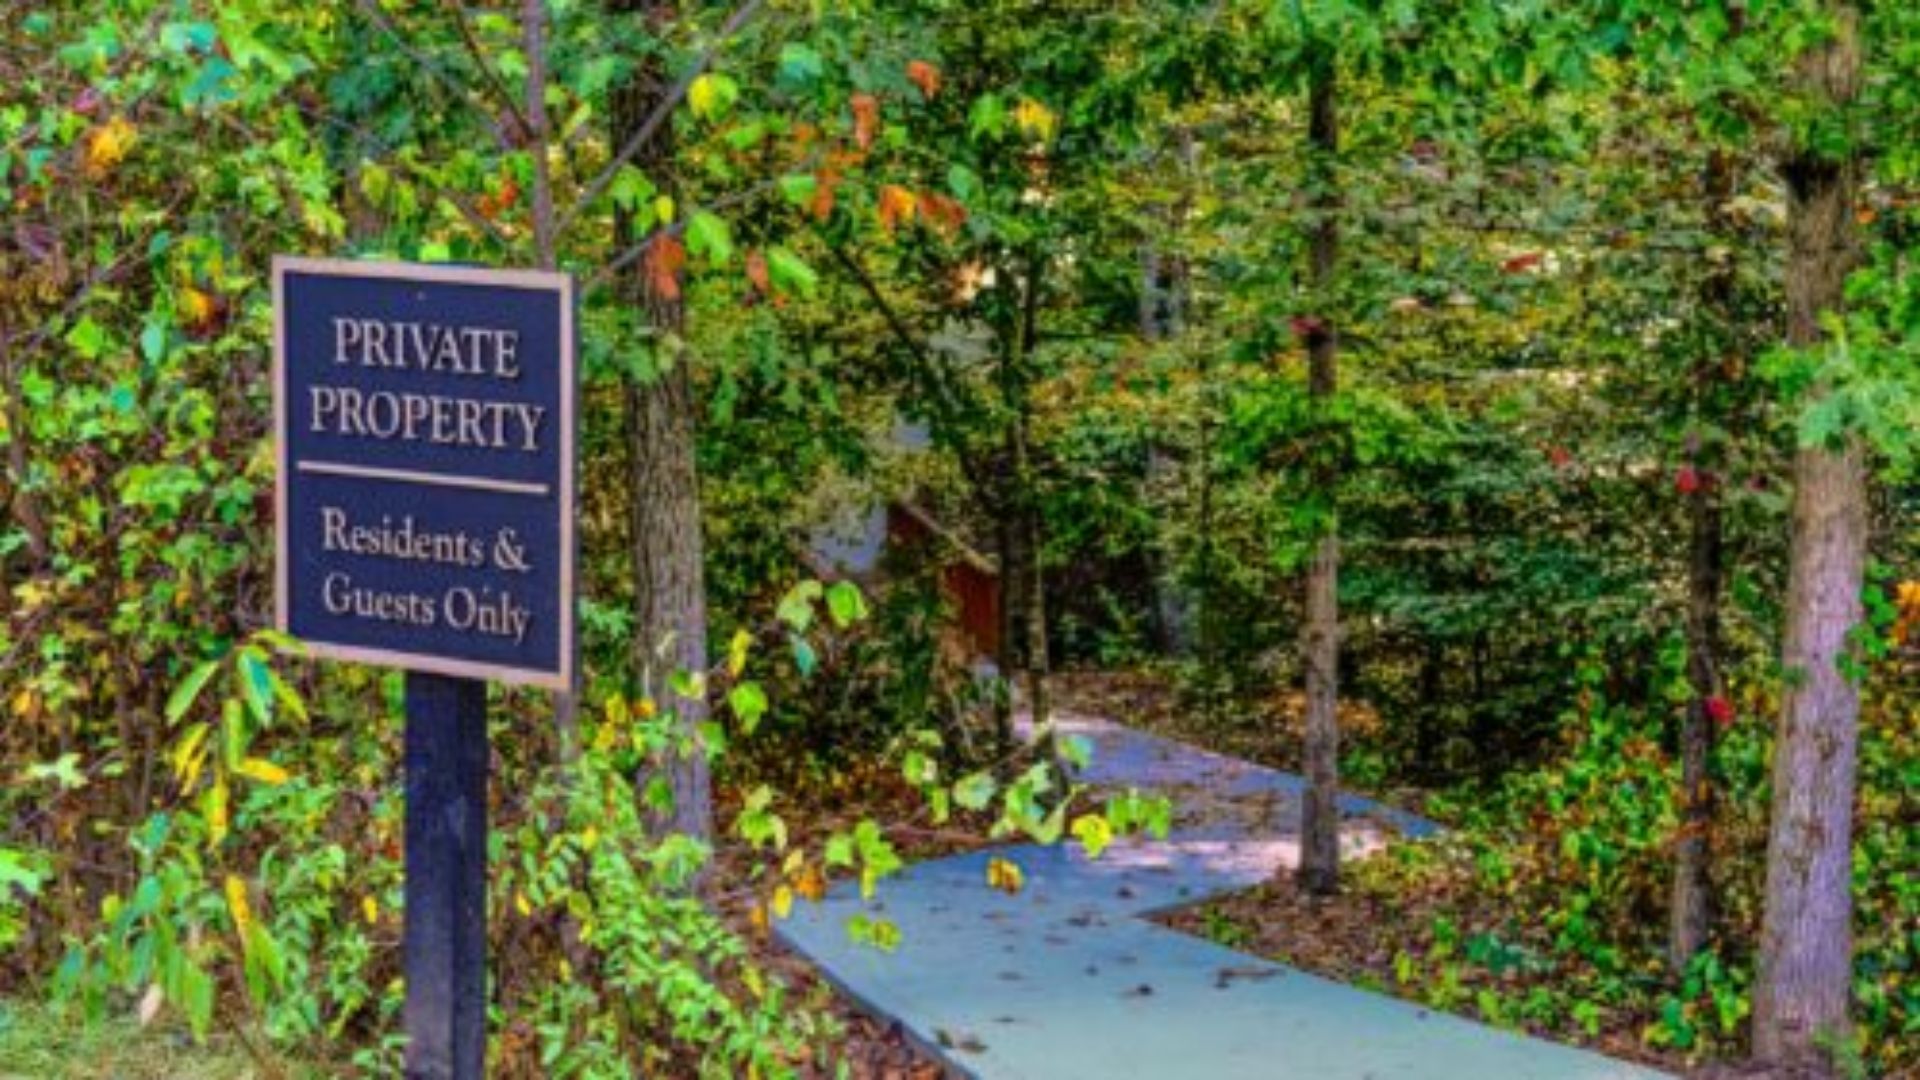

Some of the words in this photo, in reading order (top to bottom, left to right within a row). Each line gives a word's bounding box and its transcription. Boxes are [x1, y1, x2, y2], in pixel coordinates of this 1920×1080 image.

[333, 317, 520, 378] PRIVATE
[309, 386, 545, 451] PROPERTY
[321, 506, 484, 566] Residents
[494, 526, 531, 571] &
[322, 572, 436, 625] Guests
[444, 586, 530, 644] Only
